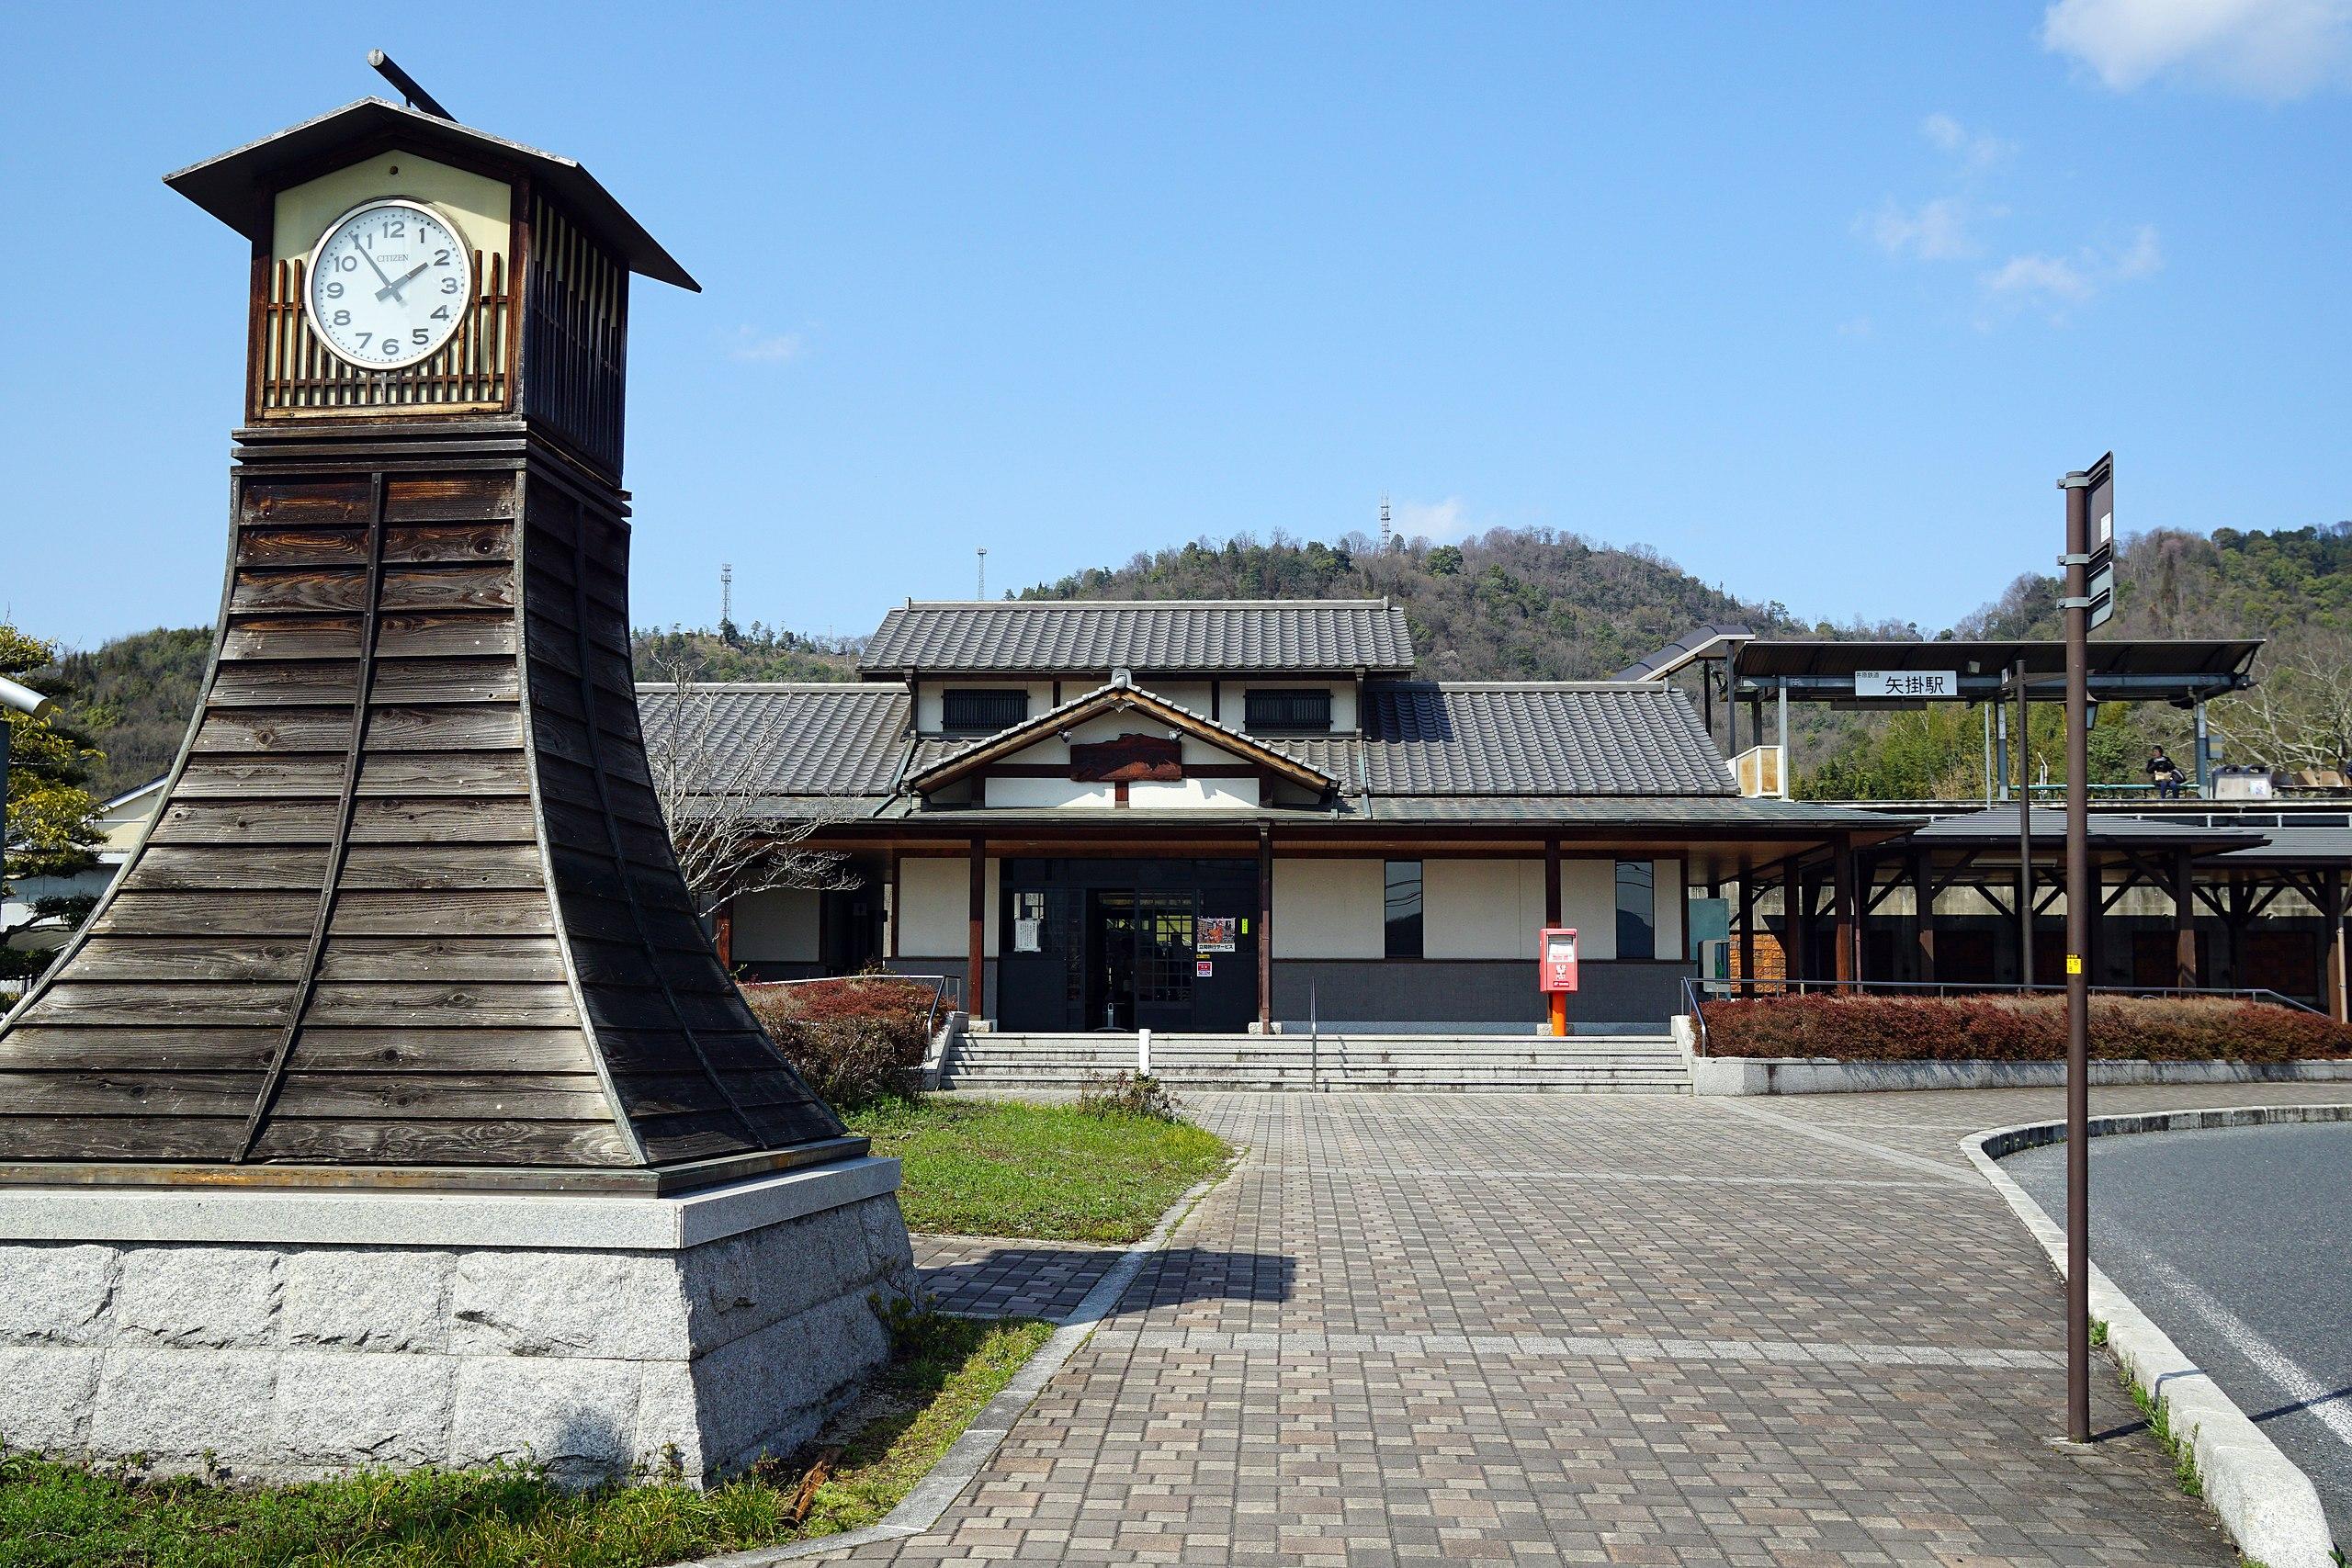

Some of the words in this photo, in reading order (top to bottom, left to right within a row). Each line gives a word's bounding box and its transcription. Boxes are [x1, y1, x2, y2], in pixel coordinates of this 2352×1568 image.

[382, 220, 404, 239] 12
[419, 227, 425, 243] 1
[353, 233, 372, 249] 11
[334, 255, 357, 272] 10
[377, 254, 409, 262] CITIZEN
[434, 249, 450, 266] 2
[326, 282, 345, 299] 9
[440, 277, 458, 294] 3
[333, 310, 351, 326] 8
[430, 304, 450, 321] 4
[355, 333, 373, 349] 7
[412, 328, 429, 345] 5
[381, 338, 400, 355] 6
[1885, 676, 1944, 694] 矢掛駅
